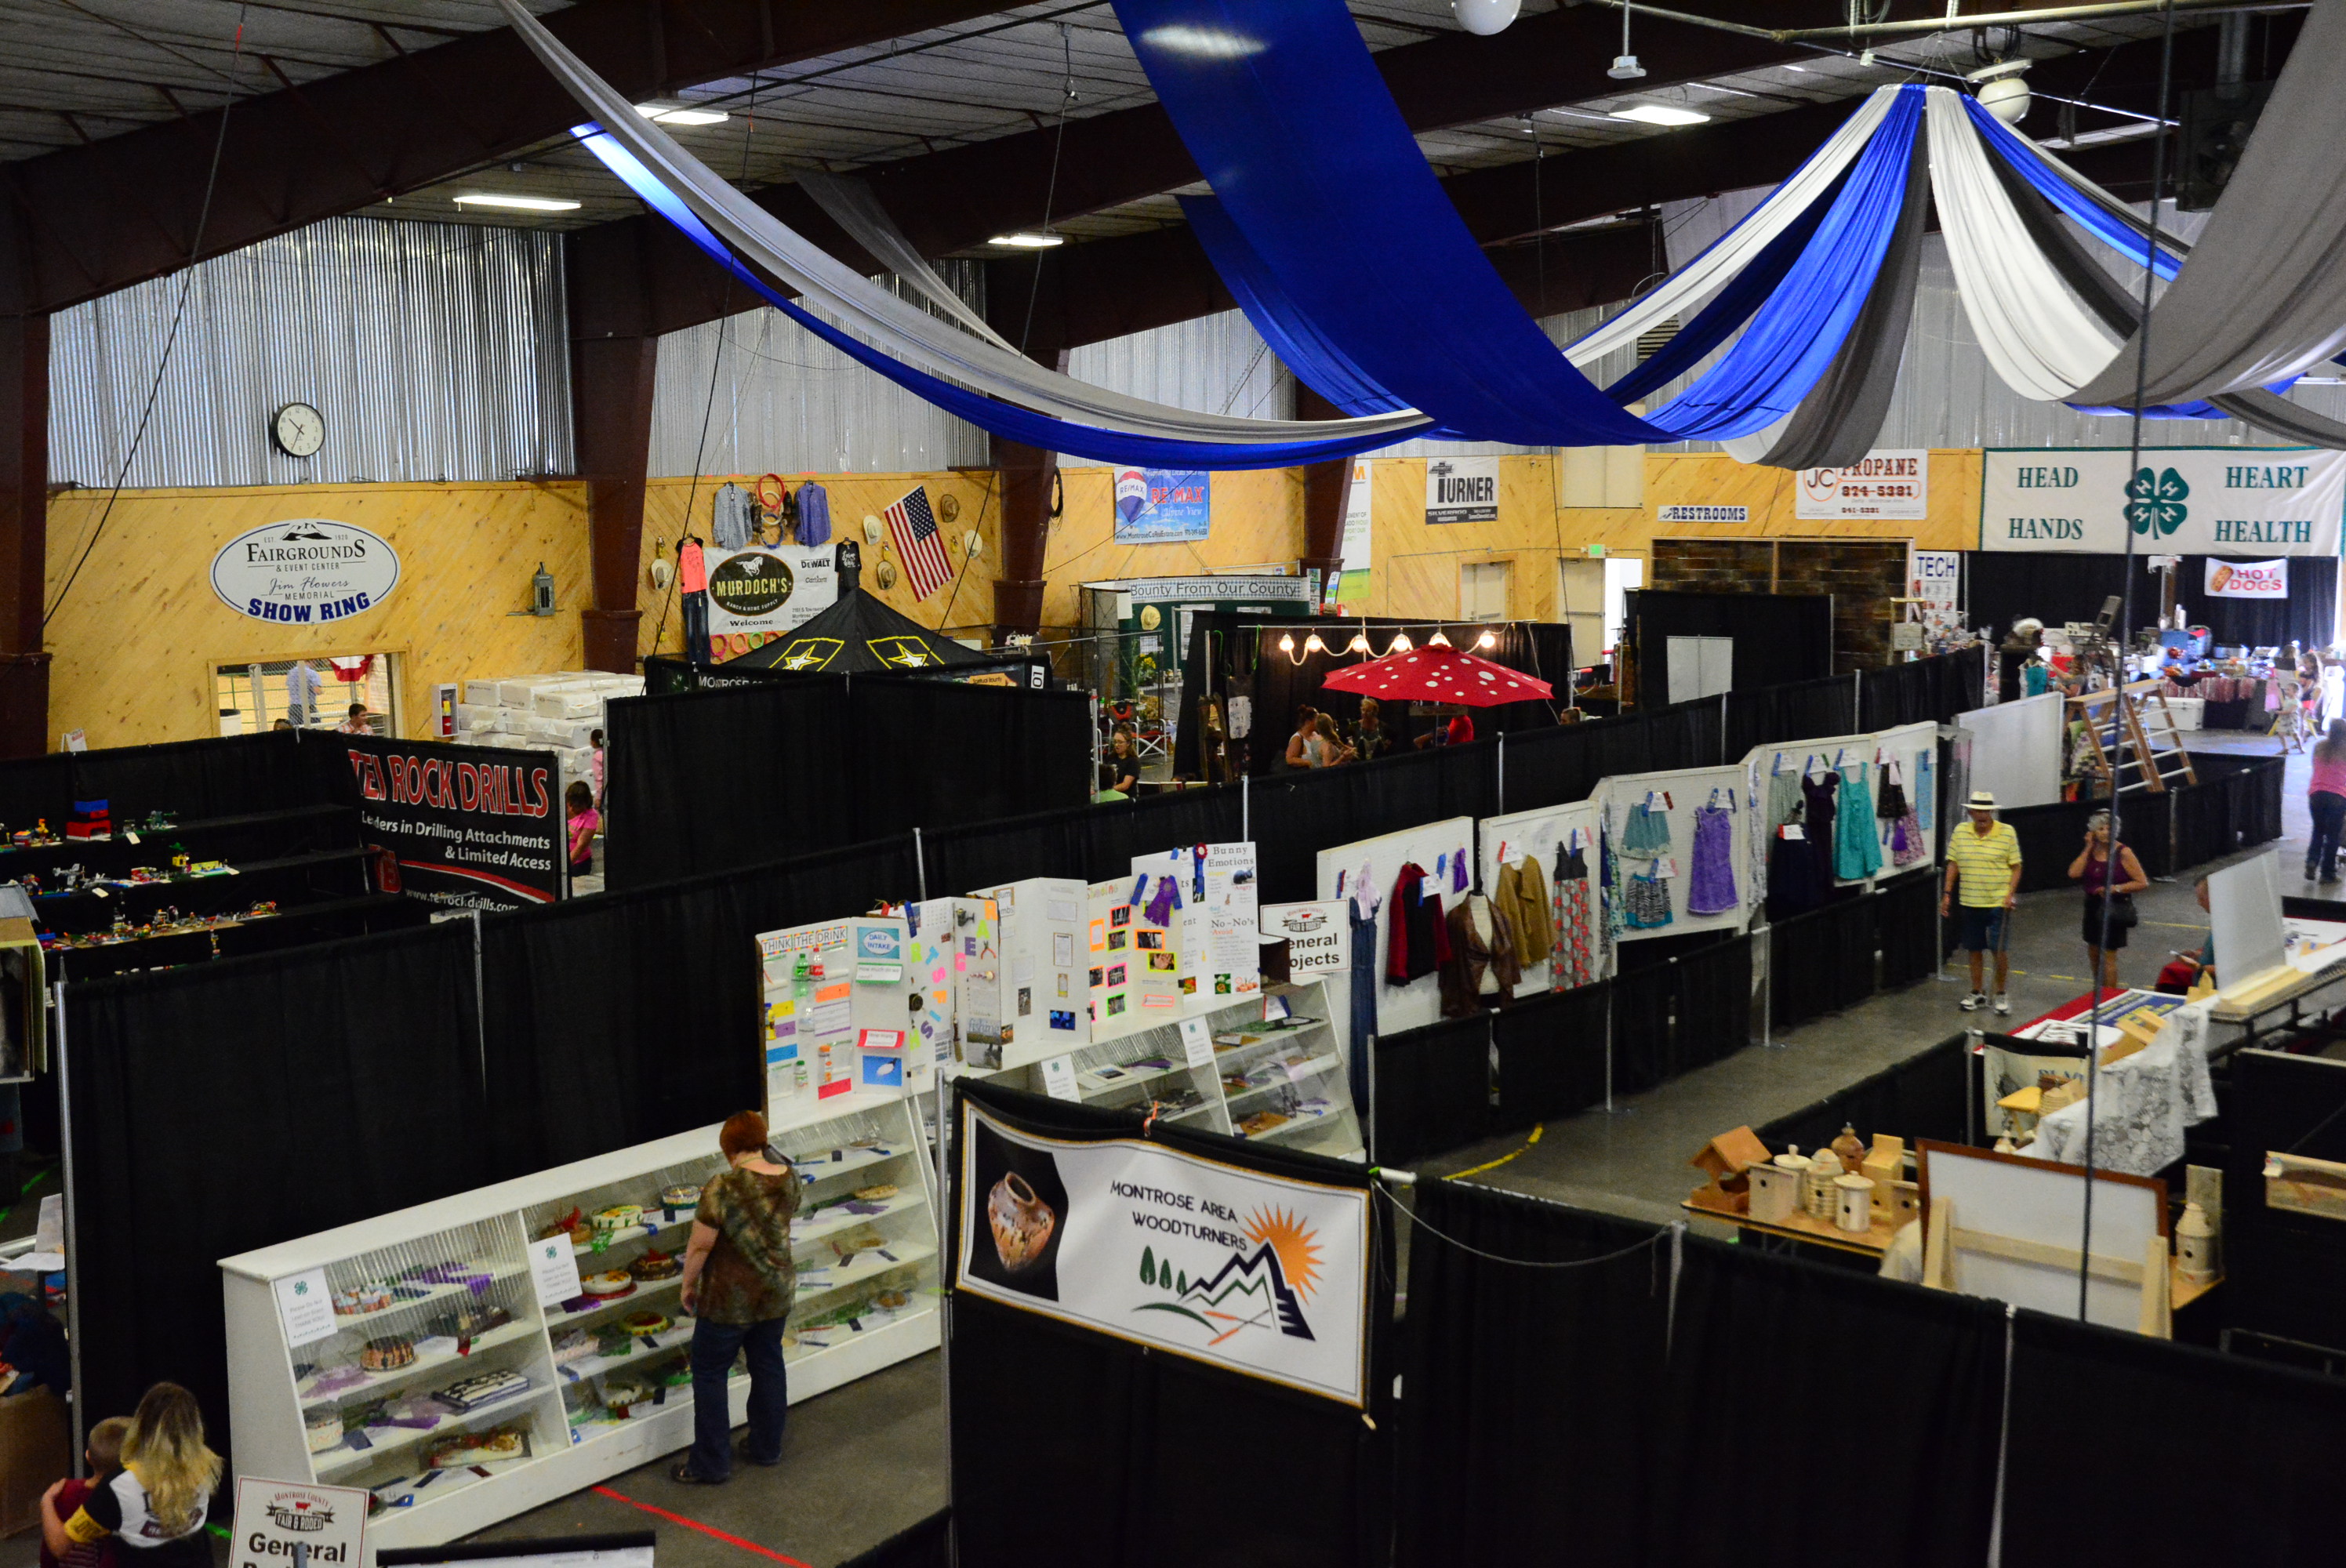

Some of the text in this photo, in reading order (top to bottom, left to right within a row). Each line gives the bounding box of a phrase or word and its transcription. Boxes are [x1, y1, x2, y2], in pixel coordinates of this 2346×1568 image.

[1807, 469, 1833, 488] JC
[2017, 466, 2079, 488] HEAD
[2224, 466, 2309, 488] HEART
[1120, 485, 1144, 494] RE/MAX
[1151, 486, 1204, 504] RE/MAX
[1438, 477, 1494, 503] TURNER
[1672, 506, 1745, 521] RESTROOMS
[2008, 518, 2083, 540] HANDS
[2213, 520, 2313, 543] HEALTH
[246, 539, 366, 562] FAIRGROUNDS
[285, 562, 307, 572] EVENT
[311, 562, 340, 571] CENTER
[1917, 556, 1956, 577] TECH
[2236, 568, 2276, 580] HOT
[269, 576, 350, 596] Jim Flowers
[716, 577, 788, 597] MURDOCH'S
[1131, 583, 1296, 597] Bounty From Our County
[2229, 579, 2282, 591] DOGS
[285, 591, 335, 601] MEMORIAL
[726, 601, 742, 612] RANCH
[761, 598, 779, 611] SUPPLY
[247, 592, 371, 622] SHOW RING
[729, 619, 774, 627] Welcome
[387, 755, 457, 810] ROCK
[457, 763, 549, 818] DRILLS
[401, 819, 412, 834] in
[416, 822, 463, 844] Drilling
[465, 828, 551, 850] Attachments
[445, 845, 551, 871] & Limited Access
[1213, 846, 1248, 855] Bunny
[1208, 858, 1255, 867] Emotions
[763, 928, 846, 953] THINK THE DRINK
[1289, 933, 1338, 950] eneral
[1290, 953, 1340, 971] ojects
[1110, 1180, 1239, 1223] MONTROSE AREA
[1132, 1211, 1247, 1251] WOODTURNERS
[277, 1512, 322, 1530] FAIR & RODEO
